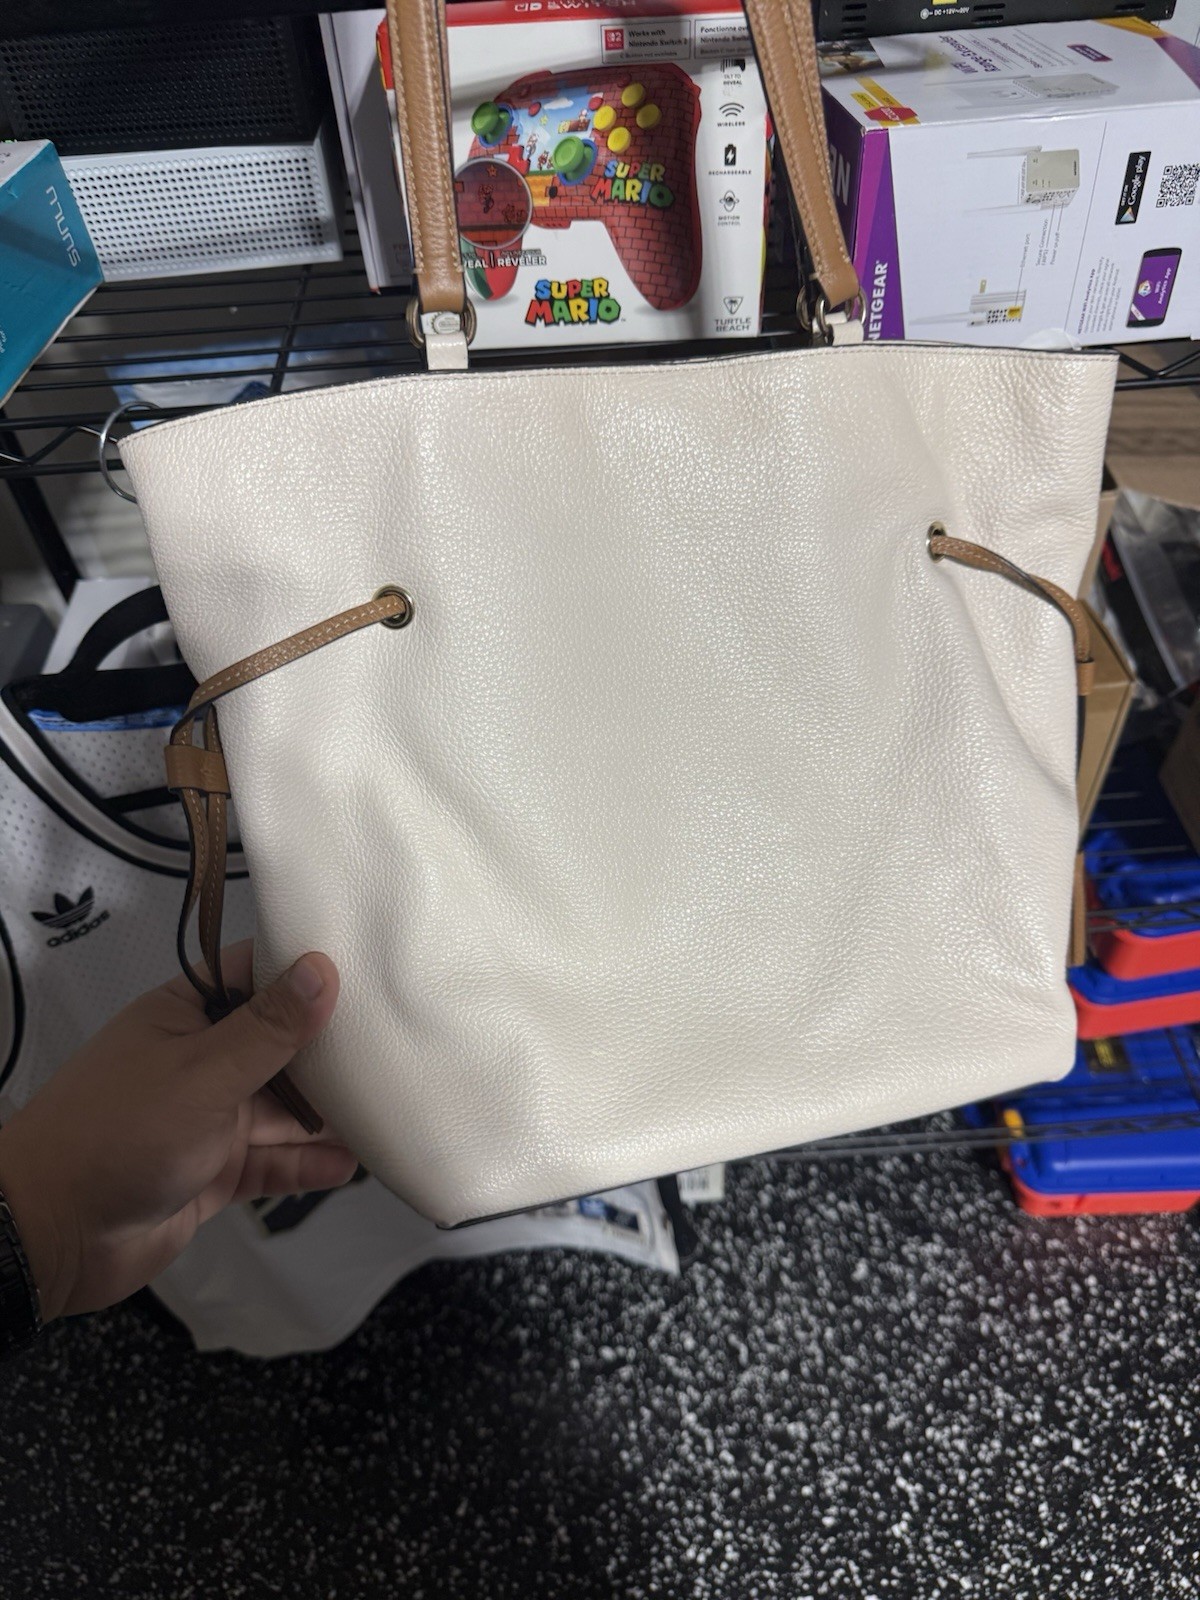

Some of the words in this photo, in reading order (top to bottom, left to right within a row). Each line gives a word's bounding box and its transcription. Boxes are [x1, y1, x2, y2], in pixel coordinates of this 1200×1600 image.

[603, 159, 667, 182] SUPER
[1127, 174, 1141, 206] Google
[1135, 155, 1146, 173] play
[591, 178, 677, 210] MARIO
[45, 185, 82, 268] SUNLU
[534, 277, 610, 301] SUPER
[1158, 280, 1168, 305] Analytics
[1164, 267, 1172, 279] App
[525, 297, 622, 327] MARIO
[714, 317, 752, 326] TURTLE
[715, 324, 750, 332] BEACH
[47, 910, 110, 947] adidas
